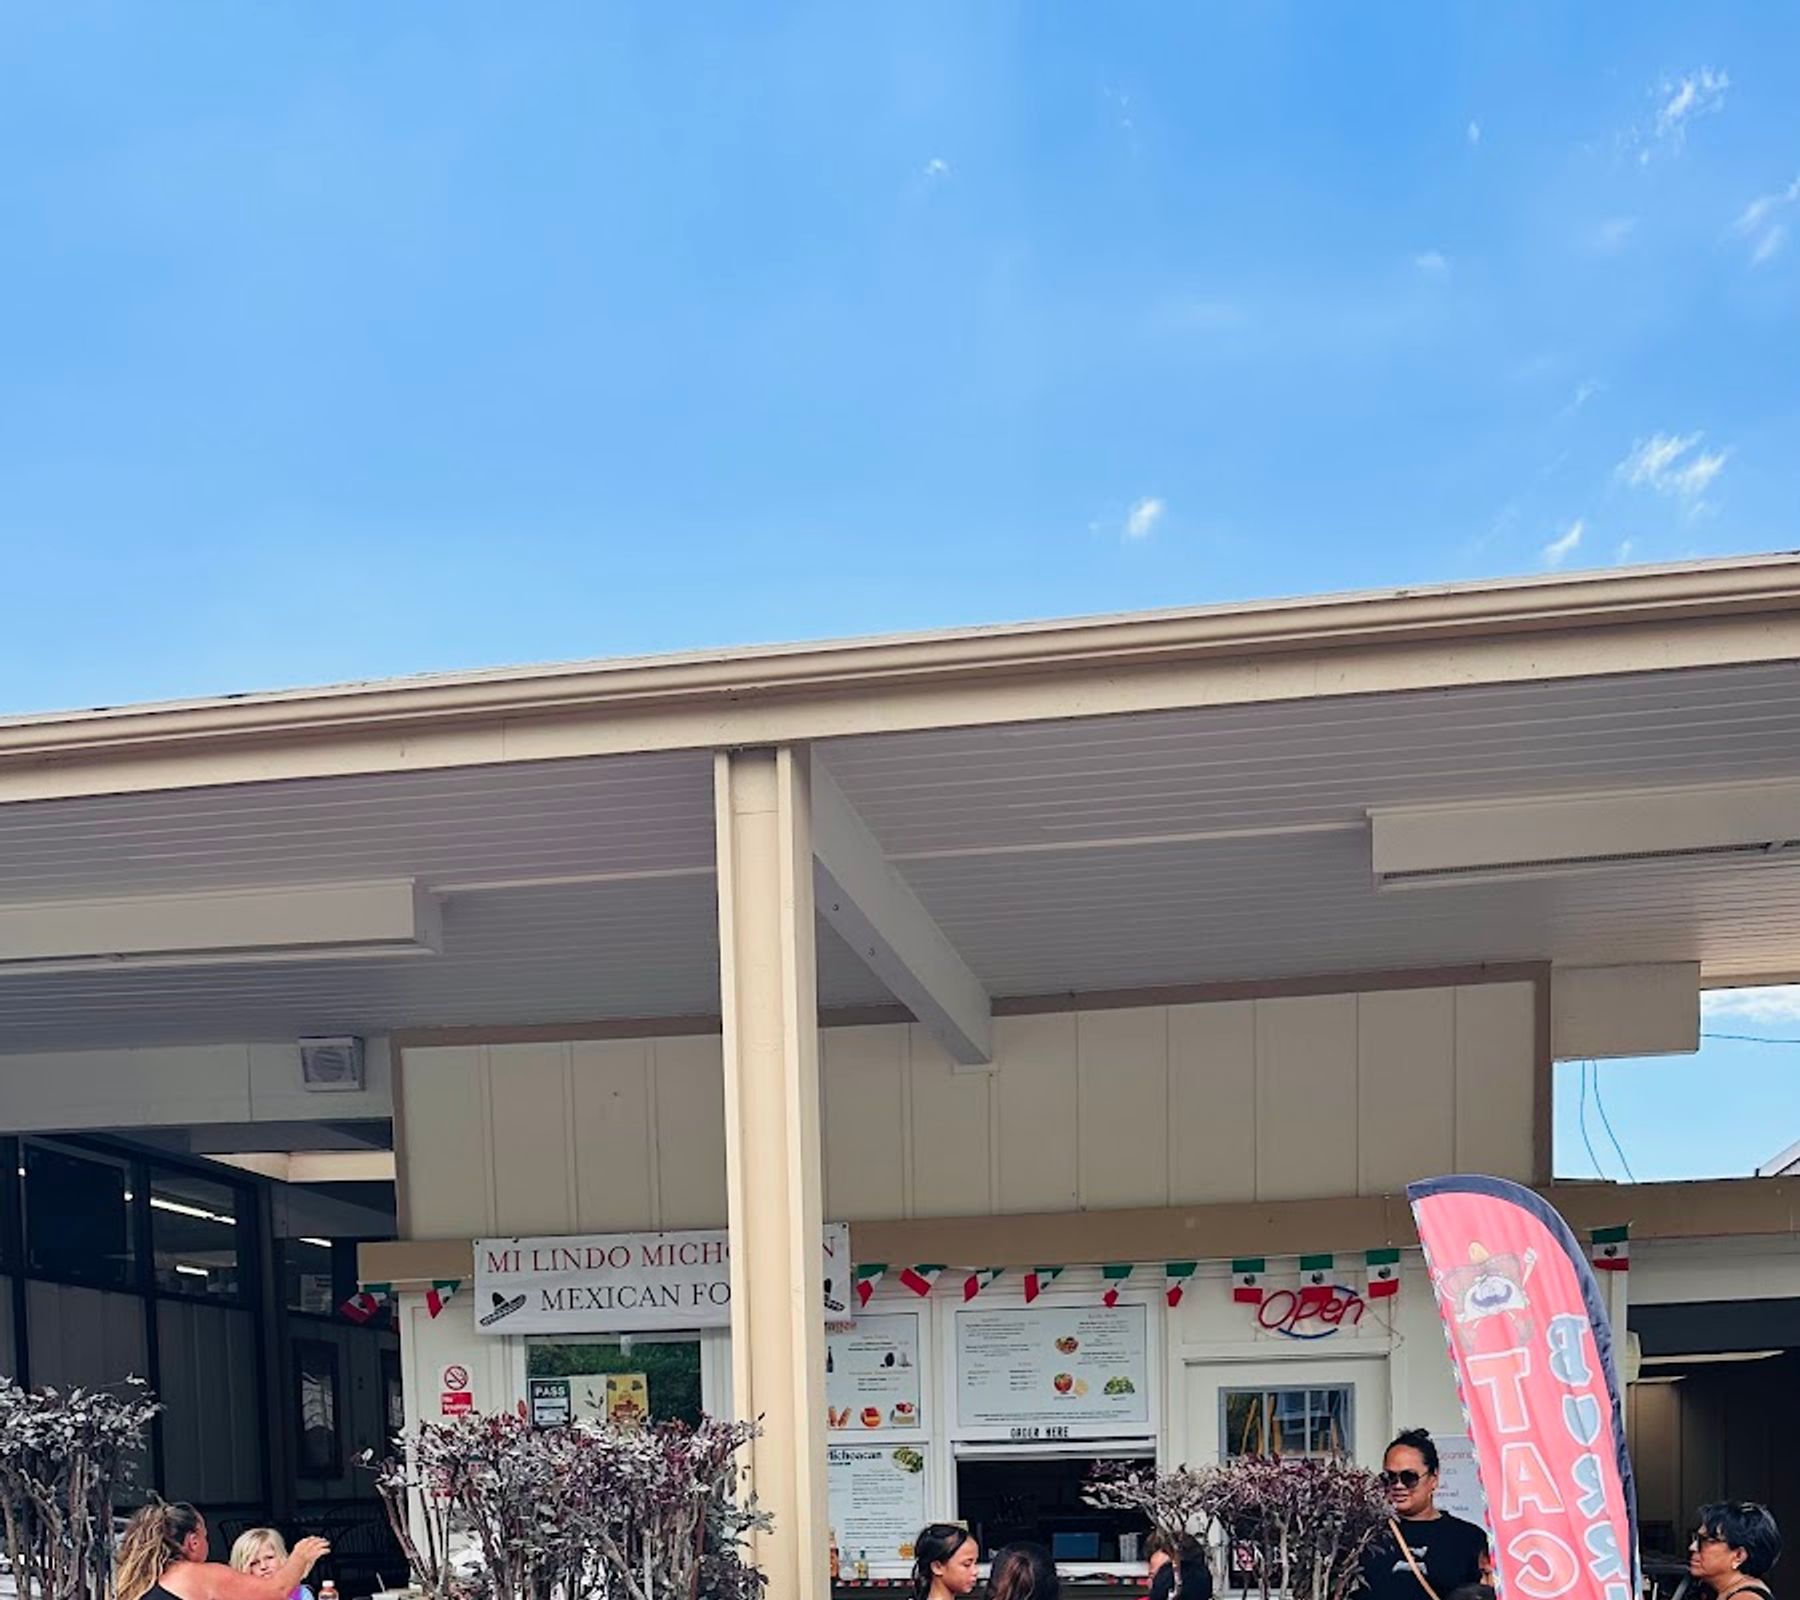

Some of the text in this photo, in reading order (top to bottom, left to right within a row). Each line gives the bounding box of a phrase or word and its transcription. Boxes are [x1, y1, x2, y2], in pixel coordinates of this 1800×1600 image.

[486, 1250, 521, 1273] MI
[532, 1246, 631, 1272] LINDO
[541, 1281, 732, 1312] MEXICAN FO
[535, 1385, 566, 1398] PASS
[1046, 1426, 1070, 1437] HERE
